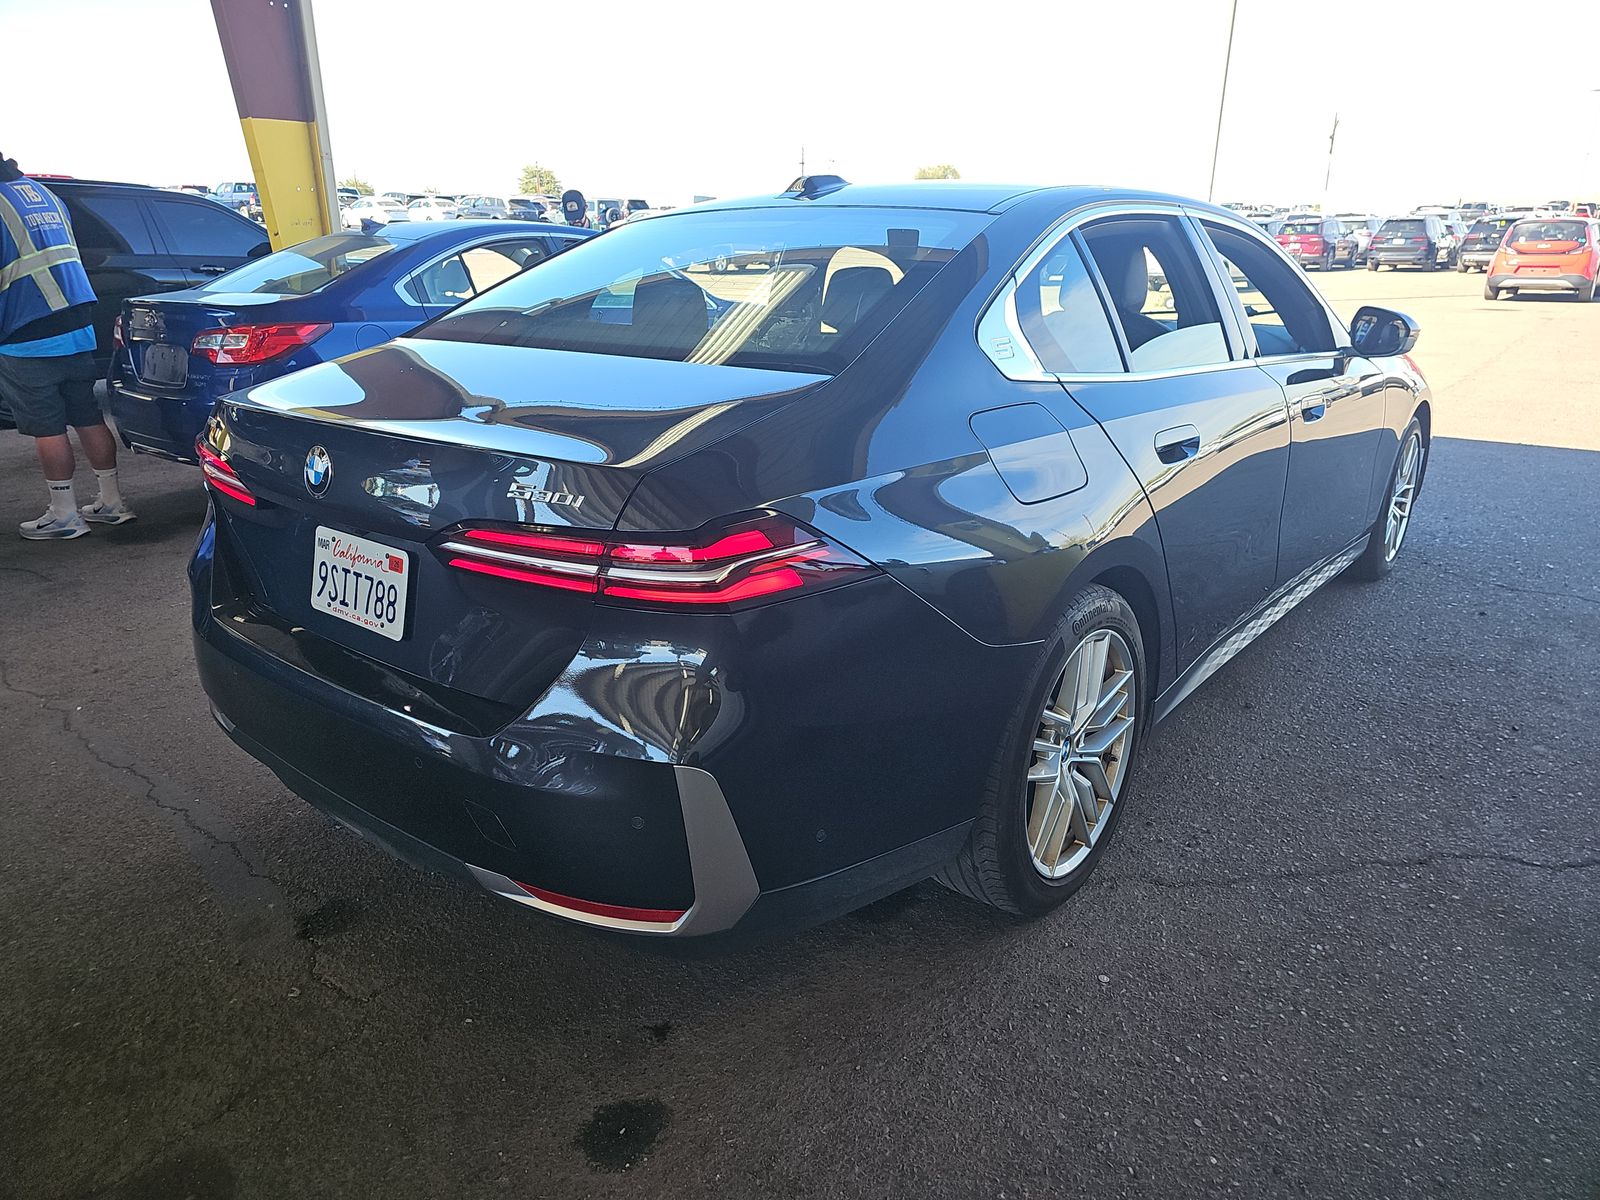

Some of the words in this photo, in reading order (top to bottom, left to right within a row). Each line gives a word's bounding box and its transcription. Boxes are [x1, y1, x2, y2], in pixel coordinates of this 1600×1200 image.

[506, 482, 585, 508] 530i
[317, 537, 330, 550] MAR
[332, 539, 389, 573] California
[317, 561, 397, 624] 9SIT788
[332, 606, 379, 628] dmv.ca.gov
[1071, 600, 1111, 636] Continental
